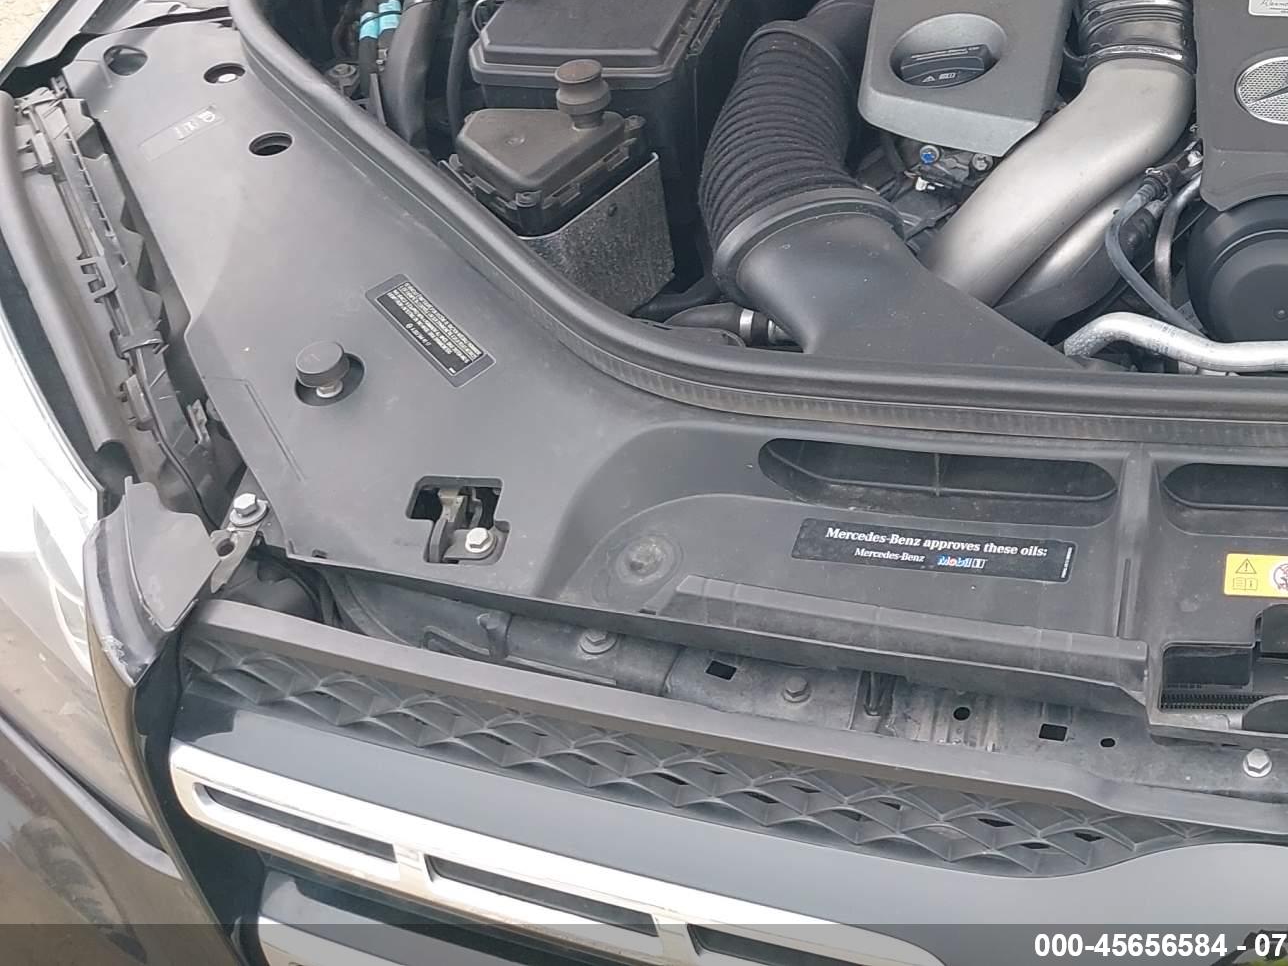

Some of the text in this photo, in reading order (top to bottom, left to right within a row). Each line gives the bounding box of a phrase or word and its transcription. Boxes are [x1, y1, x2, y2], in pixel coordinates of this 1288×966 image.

[825, 527, 1048, 557] Mercedes-Benz approves these oils:
[854, 547, 926, 563] Mercedes-Benz
